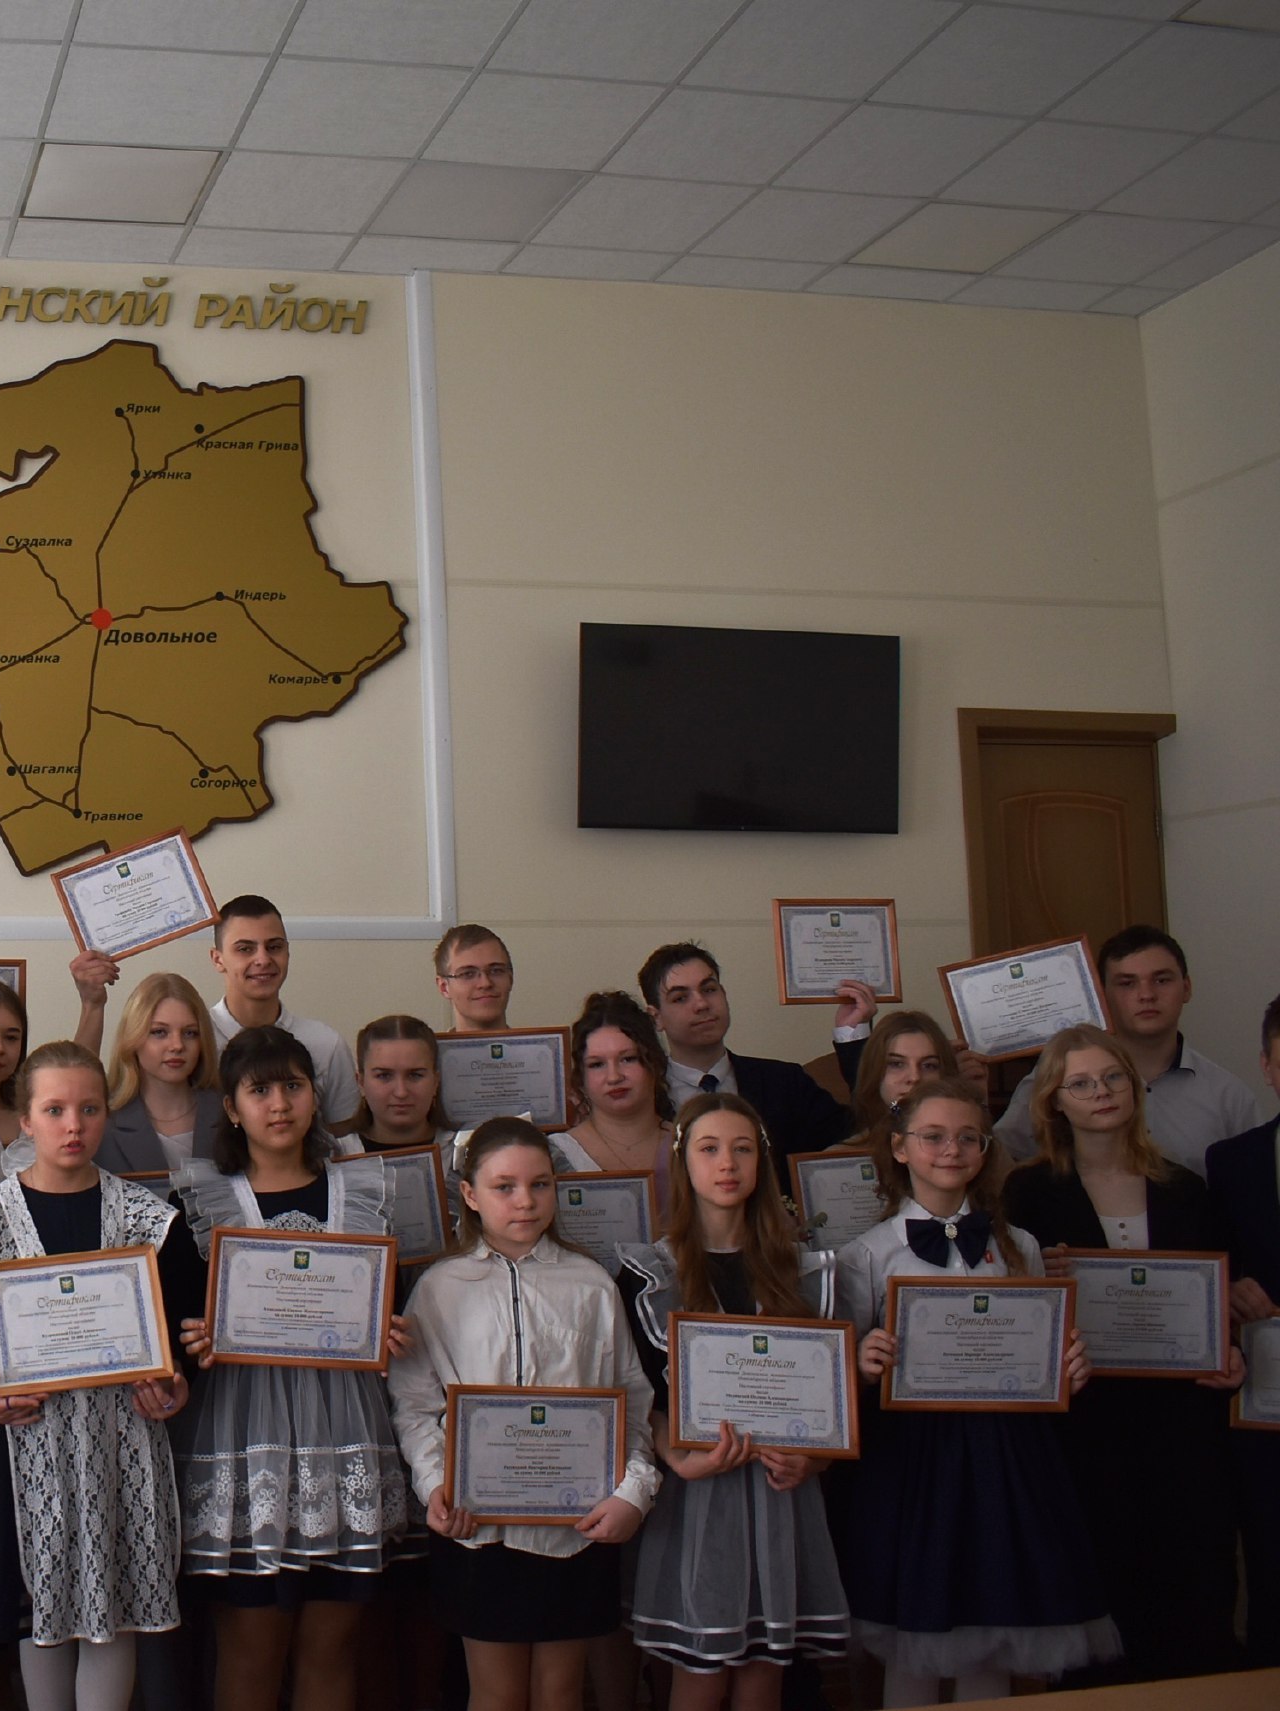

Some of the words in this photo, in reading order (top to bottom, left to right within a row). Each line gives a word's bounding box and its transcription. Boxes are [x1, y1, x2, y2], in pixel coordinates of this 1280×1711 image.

[194, 283, 368, 334] РАЙОН
[126, 403, 161, 415] Ярки
[196, 438, 253, 451] Красная
[258, 440, 300, 452] Грива
[143, 470, 192, 480] Утянка
[6, 535, 73, 548] Суздалка
[234, 589, 287, 602] Индерь
[104, 629, 218, 645] Довольное
[268, 674, 329, 686] Комарье
[19, 764, 81, 775] Шагалка
[190, 778, 257, 790] Согорное
[84, 811, 144, 823] Травное
[265, 1268, 336, 1285] Сертификат
[725, 1352, 797, 1370] Сертификат
